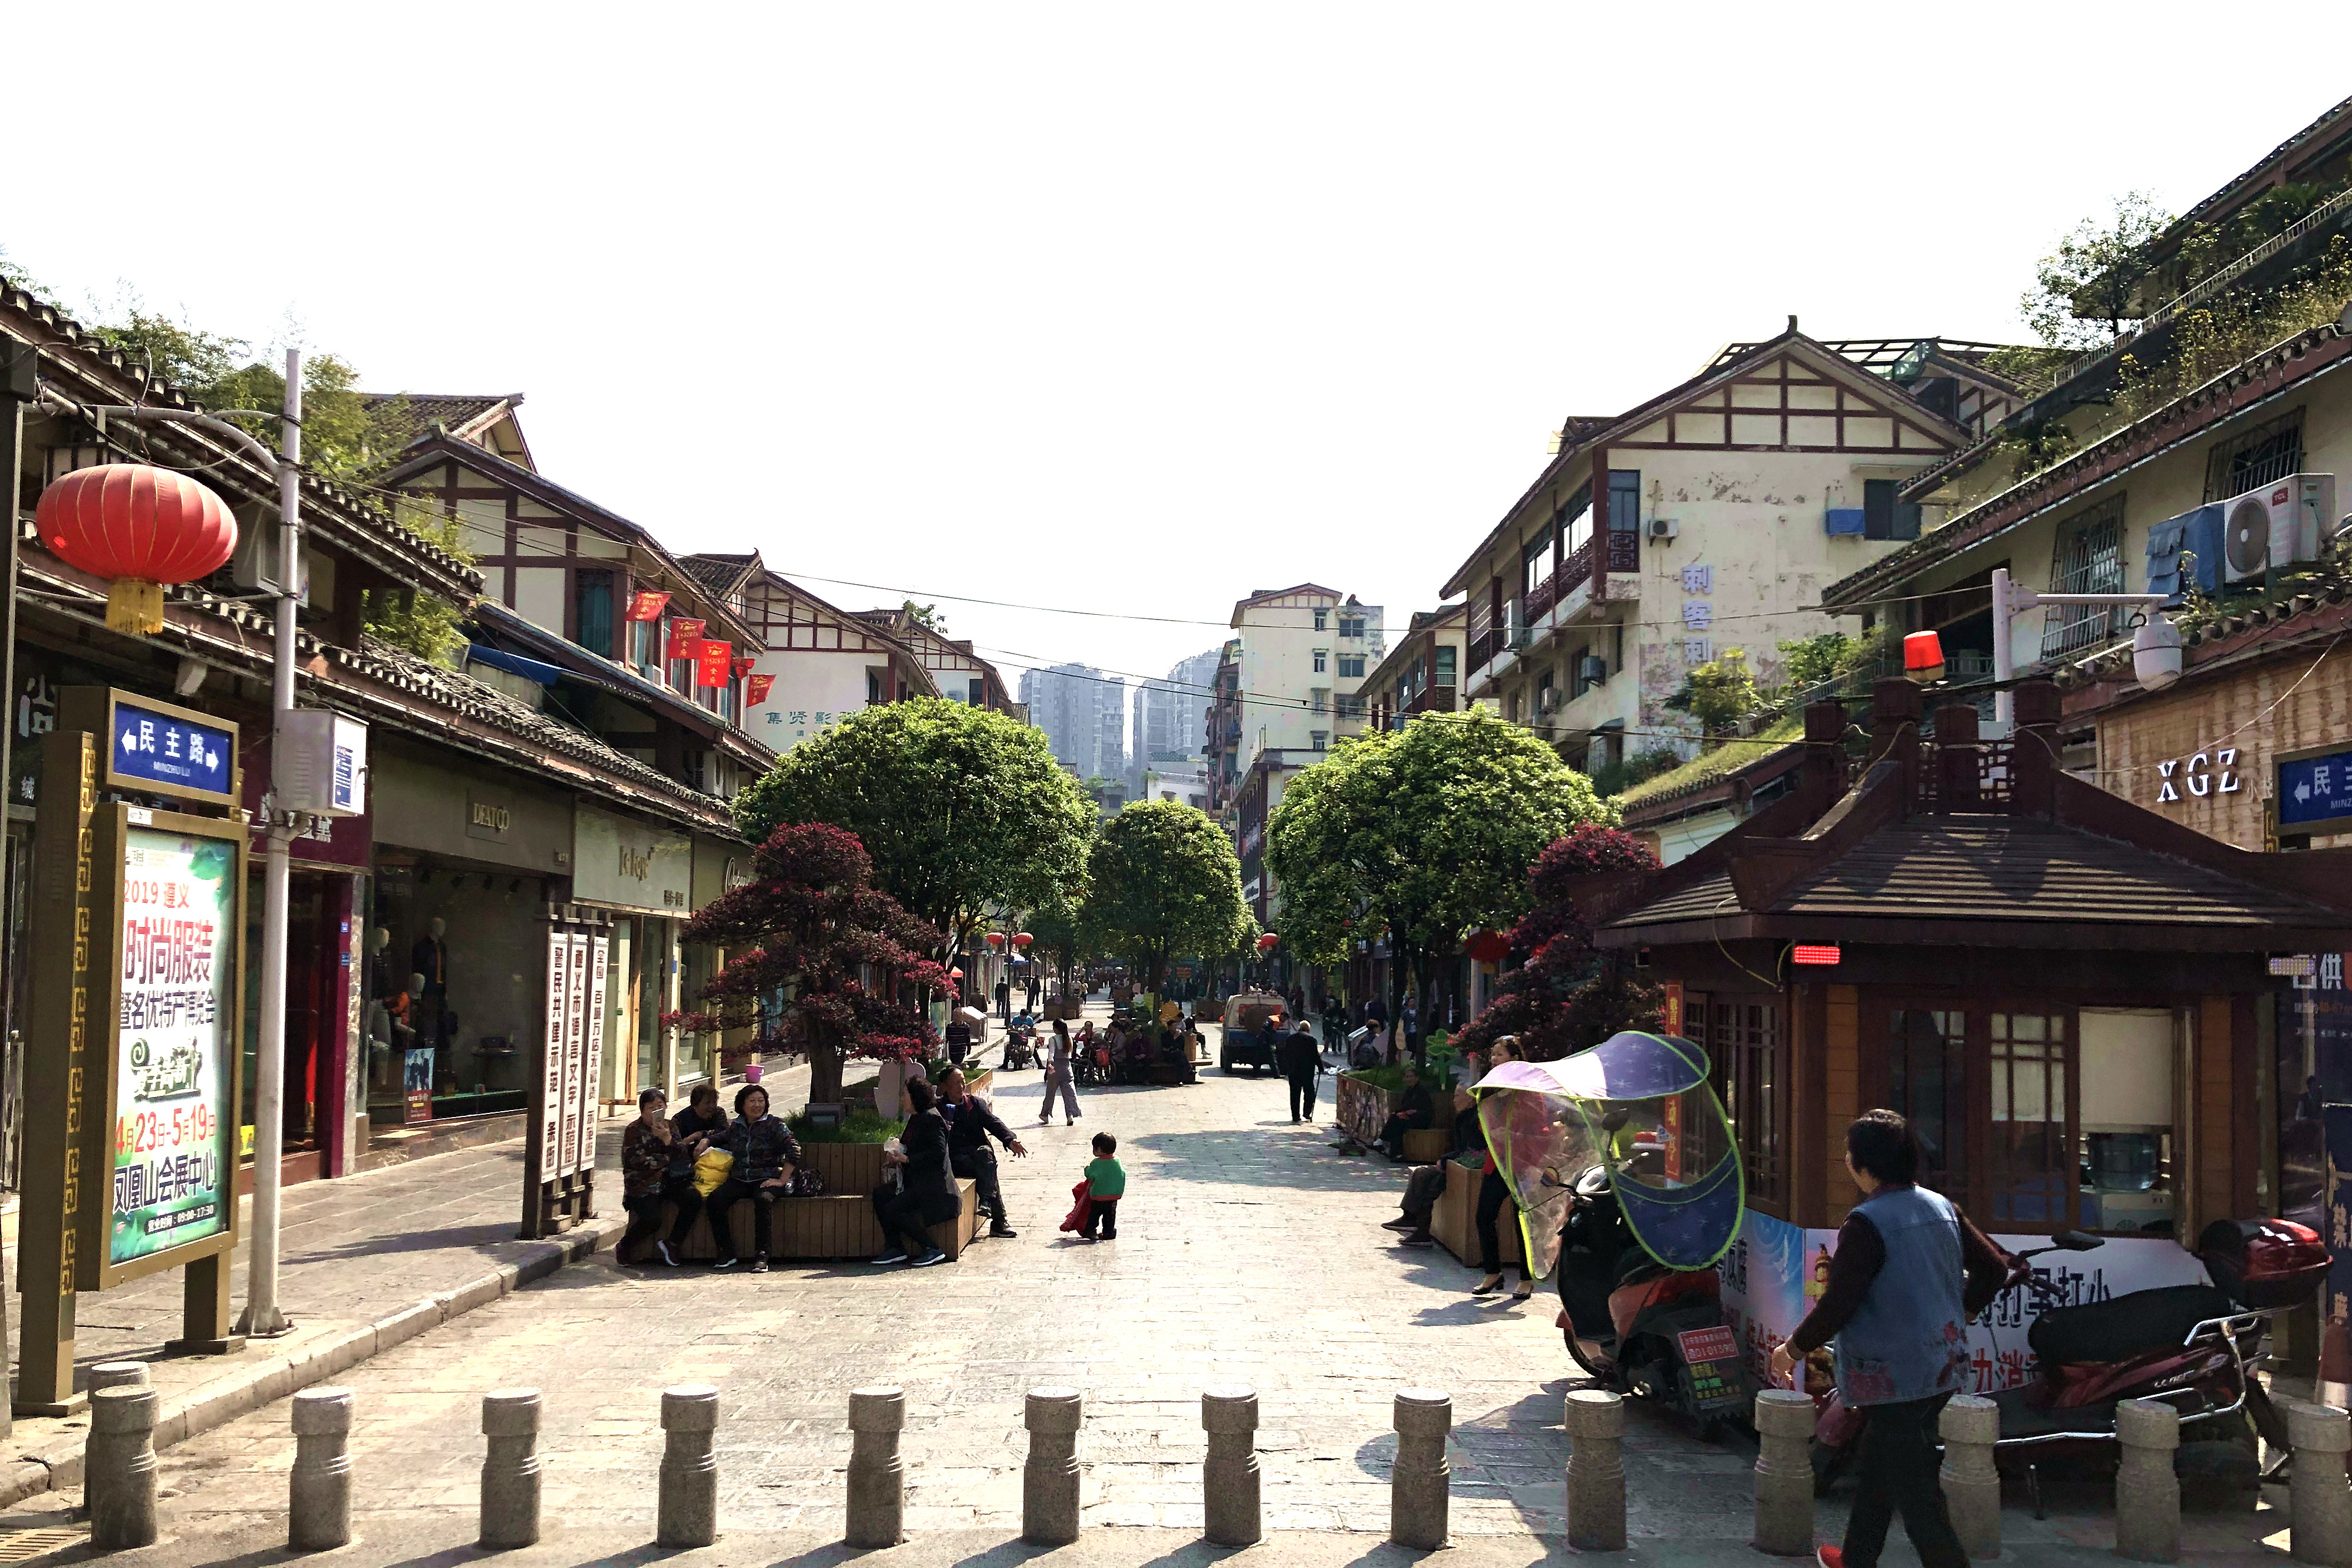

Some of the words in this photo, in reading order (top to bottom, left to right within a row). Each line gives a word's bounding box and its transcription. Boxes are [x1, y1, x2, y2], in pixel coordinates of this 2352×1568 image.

[140, 720, 205, 765] 民主路
[2157, 748, 2239, 802] XGZ
[124, 879, 159, 904] 2019
[163, 881, 190, 908] 遵义
[125, 917, 214, 984] 时尚服装
[113, 1148, 218, 1214] 凤凰山会展中心
